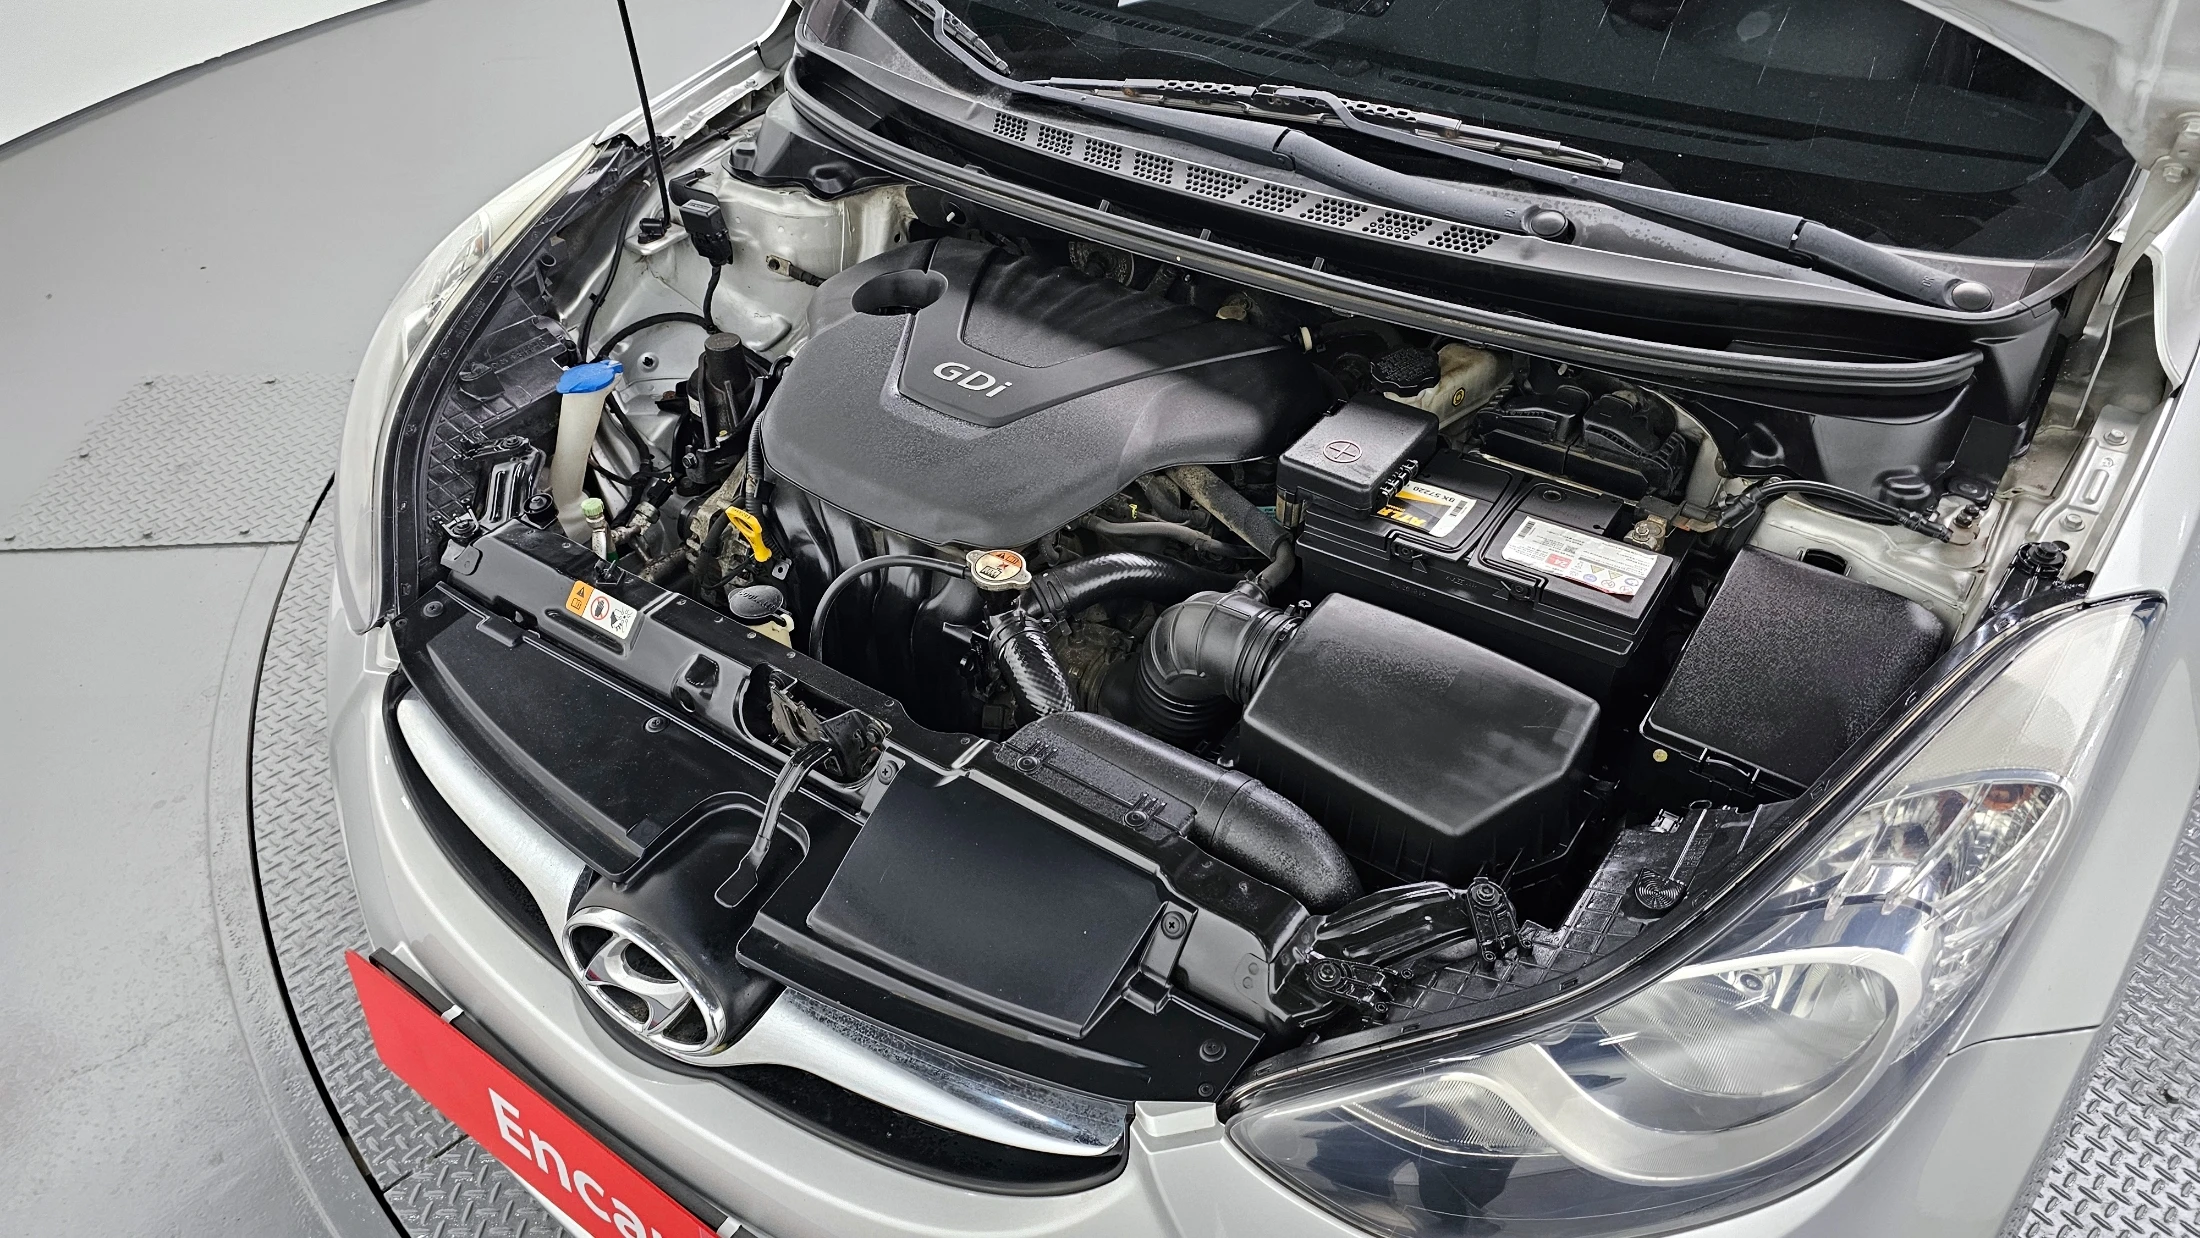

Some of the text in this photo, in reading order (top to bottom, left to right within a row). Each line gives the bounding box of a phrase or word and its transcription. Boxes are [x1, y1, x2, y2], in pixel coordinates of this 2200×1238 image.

[933, 361, 1013, 398] GDi
[1441, 495, 1456, 503] BX
[488, 1087, 663, 1238] Enca
